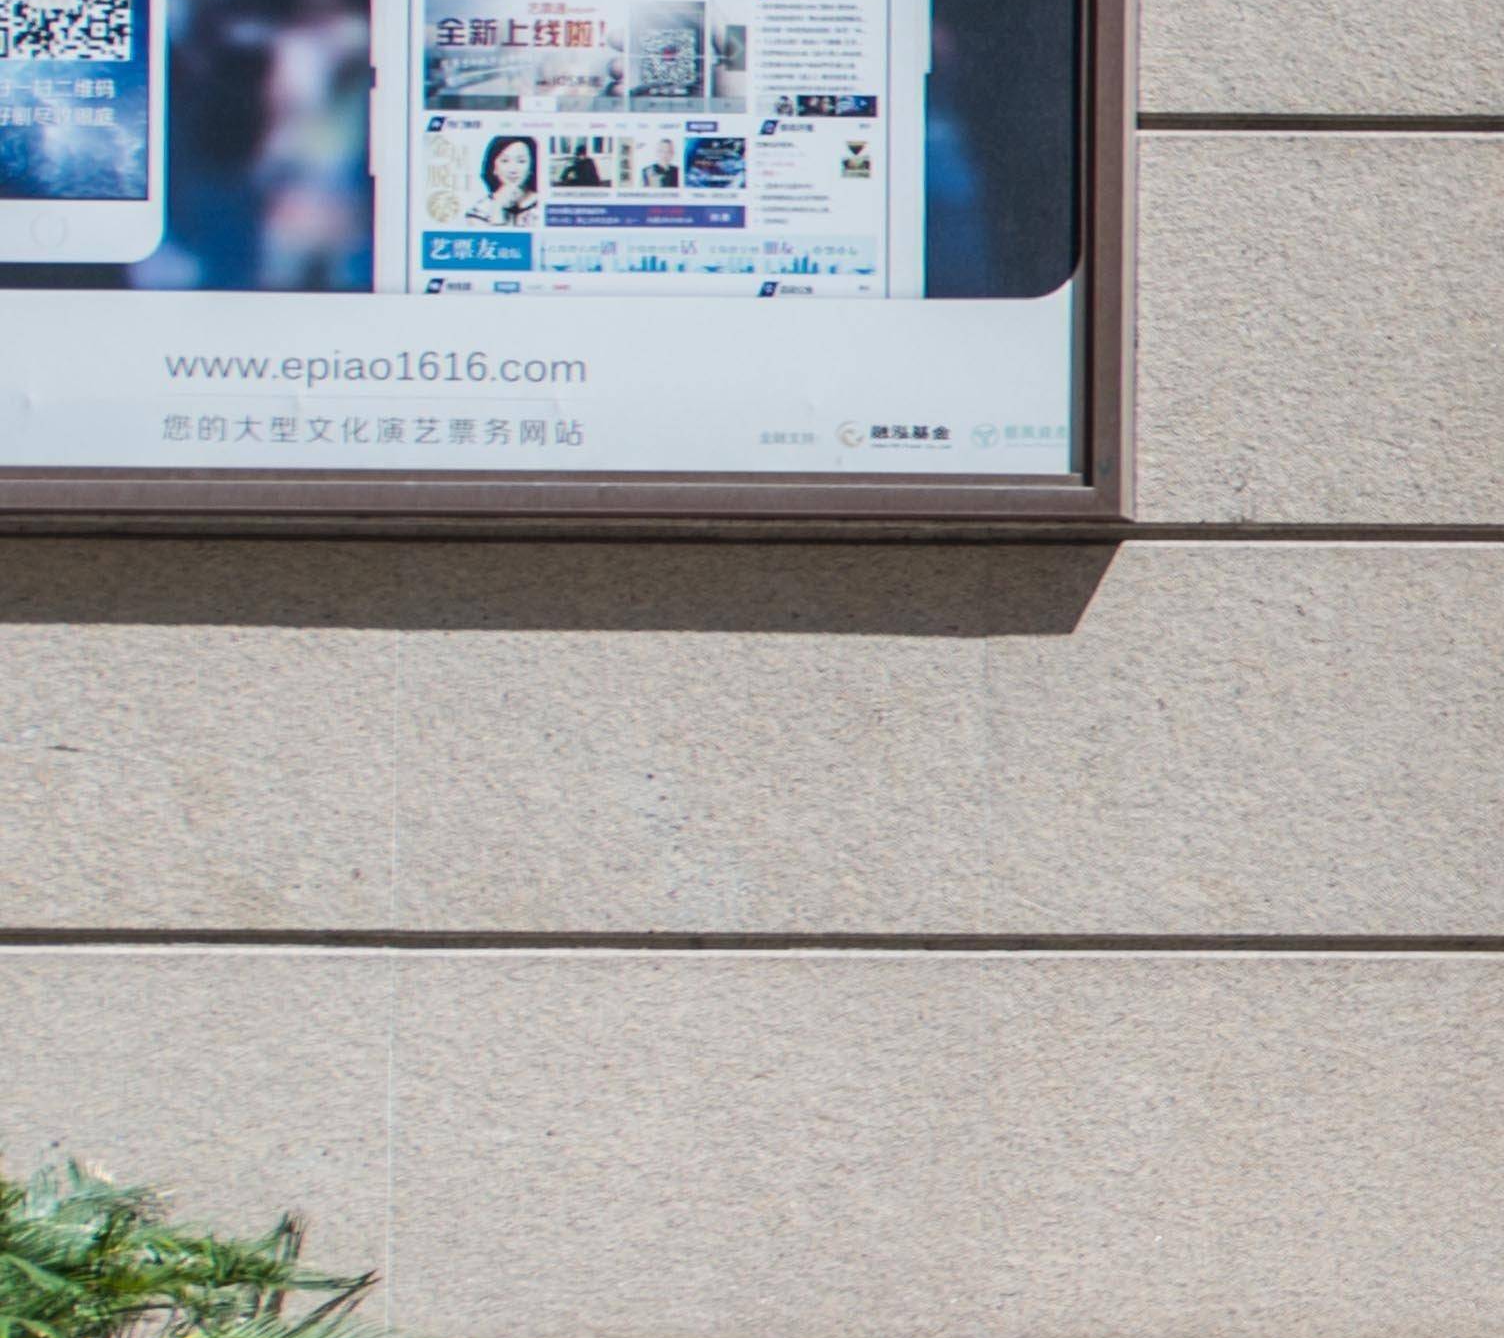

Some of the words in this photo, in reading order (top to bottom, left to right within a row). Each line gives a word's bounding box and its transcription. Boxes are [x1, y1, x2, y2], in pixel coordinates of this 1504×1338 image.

[164, 349, 587, 389] www.epiao1616.com
[162, 414, 586, 447] 您的大型文化演艺票务网站
